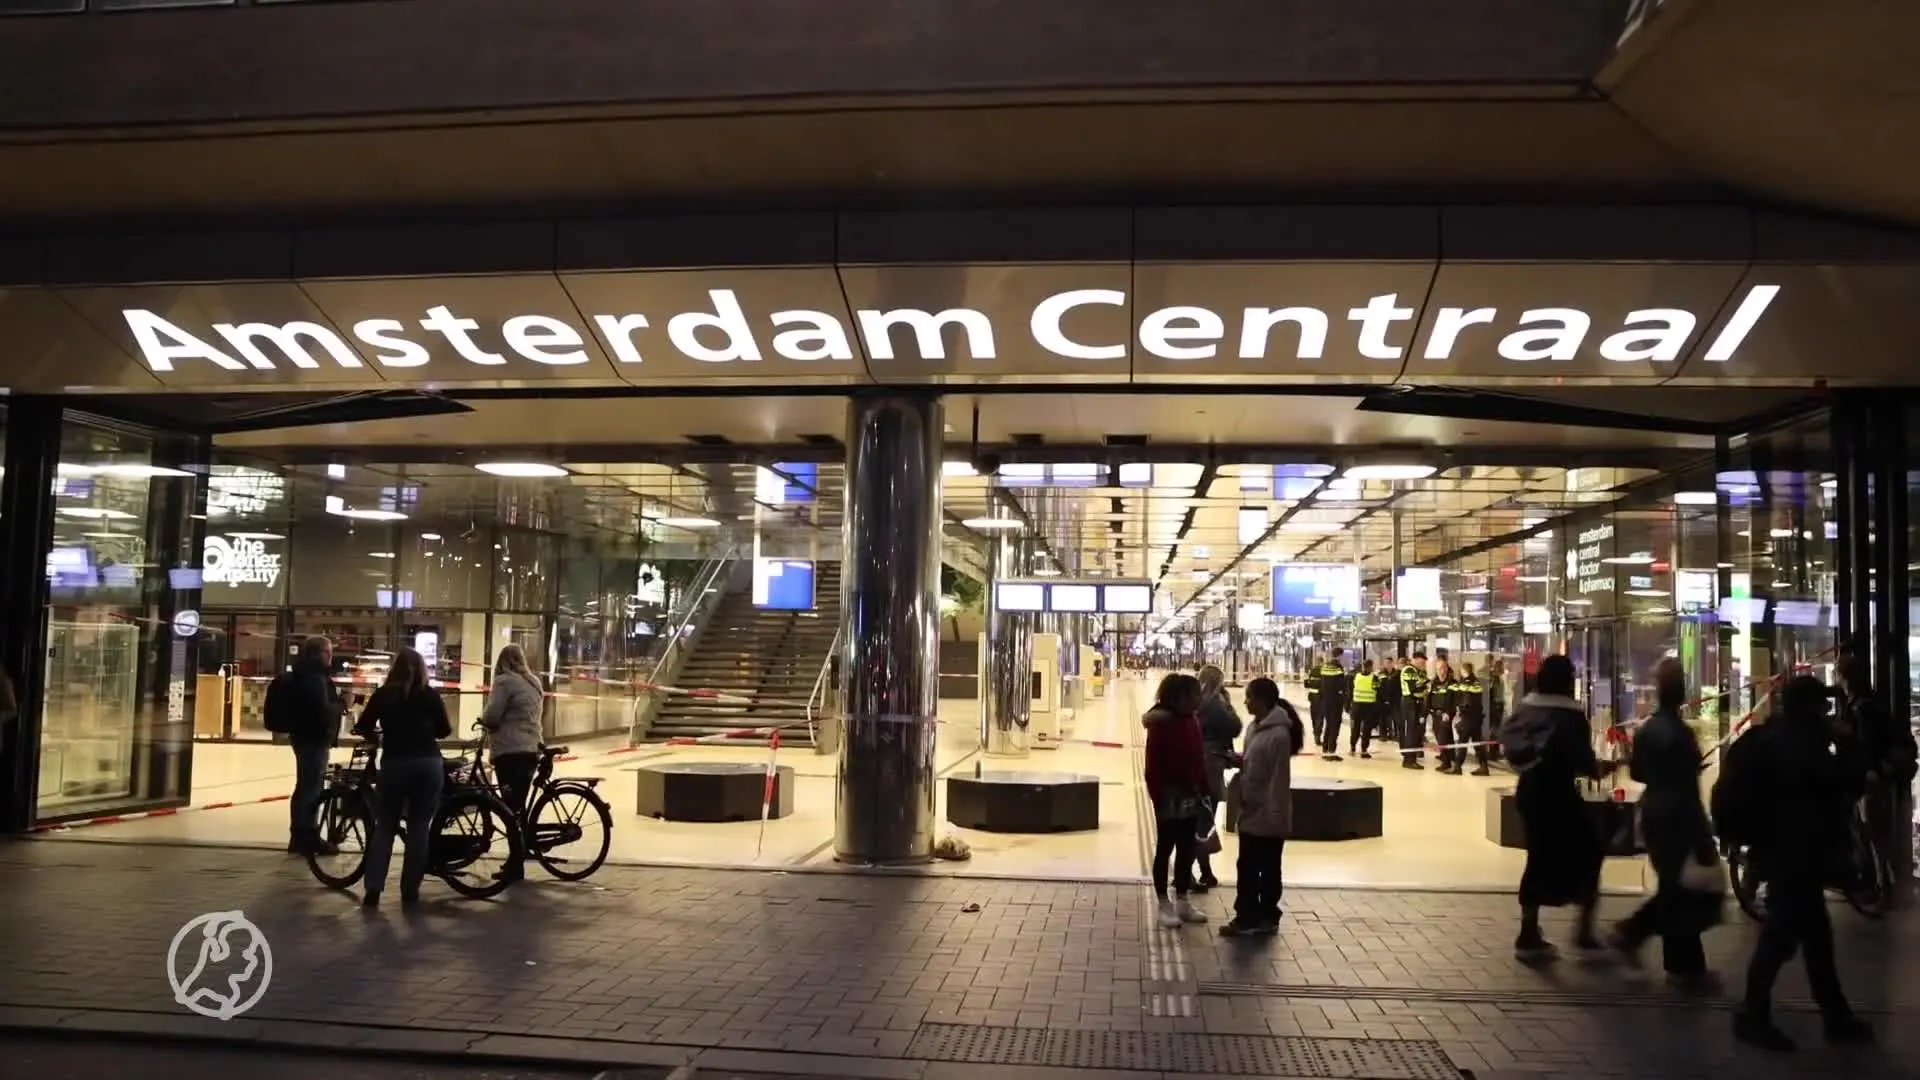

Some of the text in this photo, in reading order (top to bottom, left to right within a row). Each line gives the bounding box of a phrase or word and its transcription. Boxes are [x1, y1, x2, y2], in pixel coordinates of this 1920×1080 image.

[123, 285, 1781, 371] Amsterdam Centraal
[233, 536, 265, 555] the
[203, 567, 281, 588] mpany
